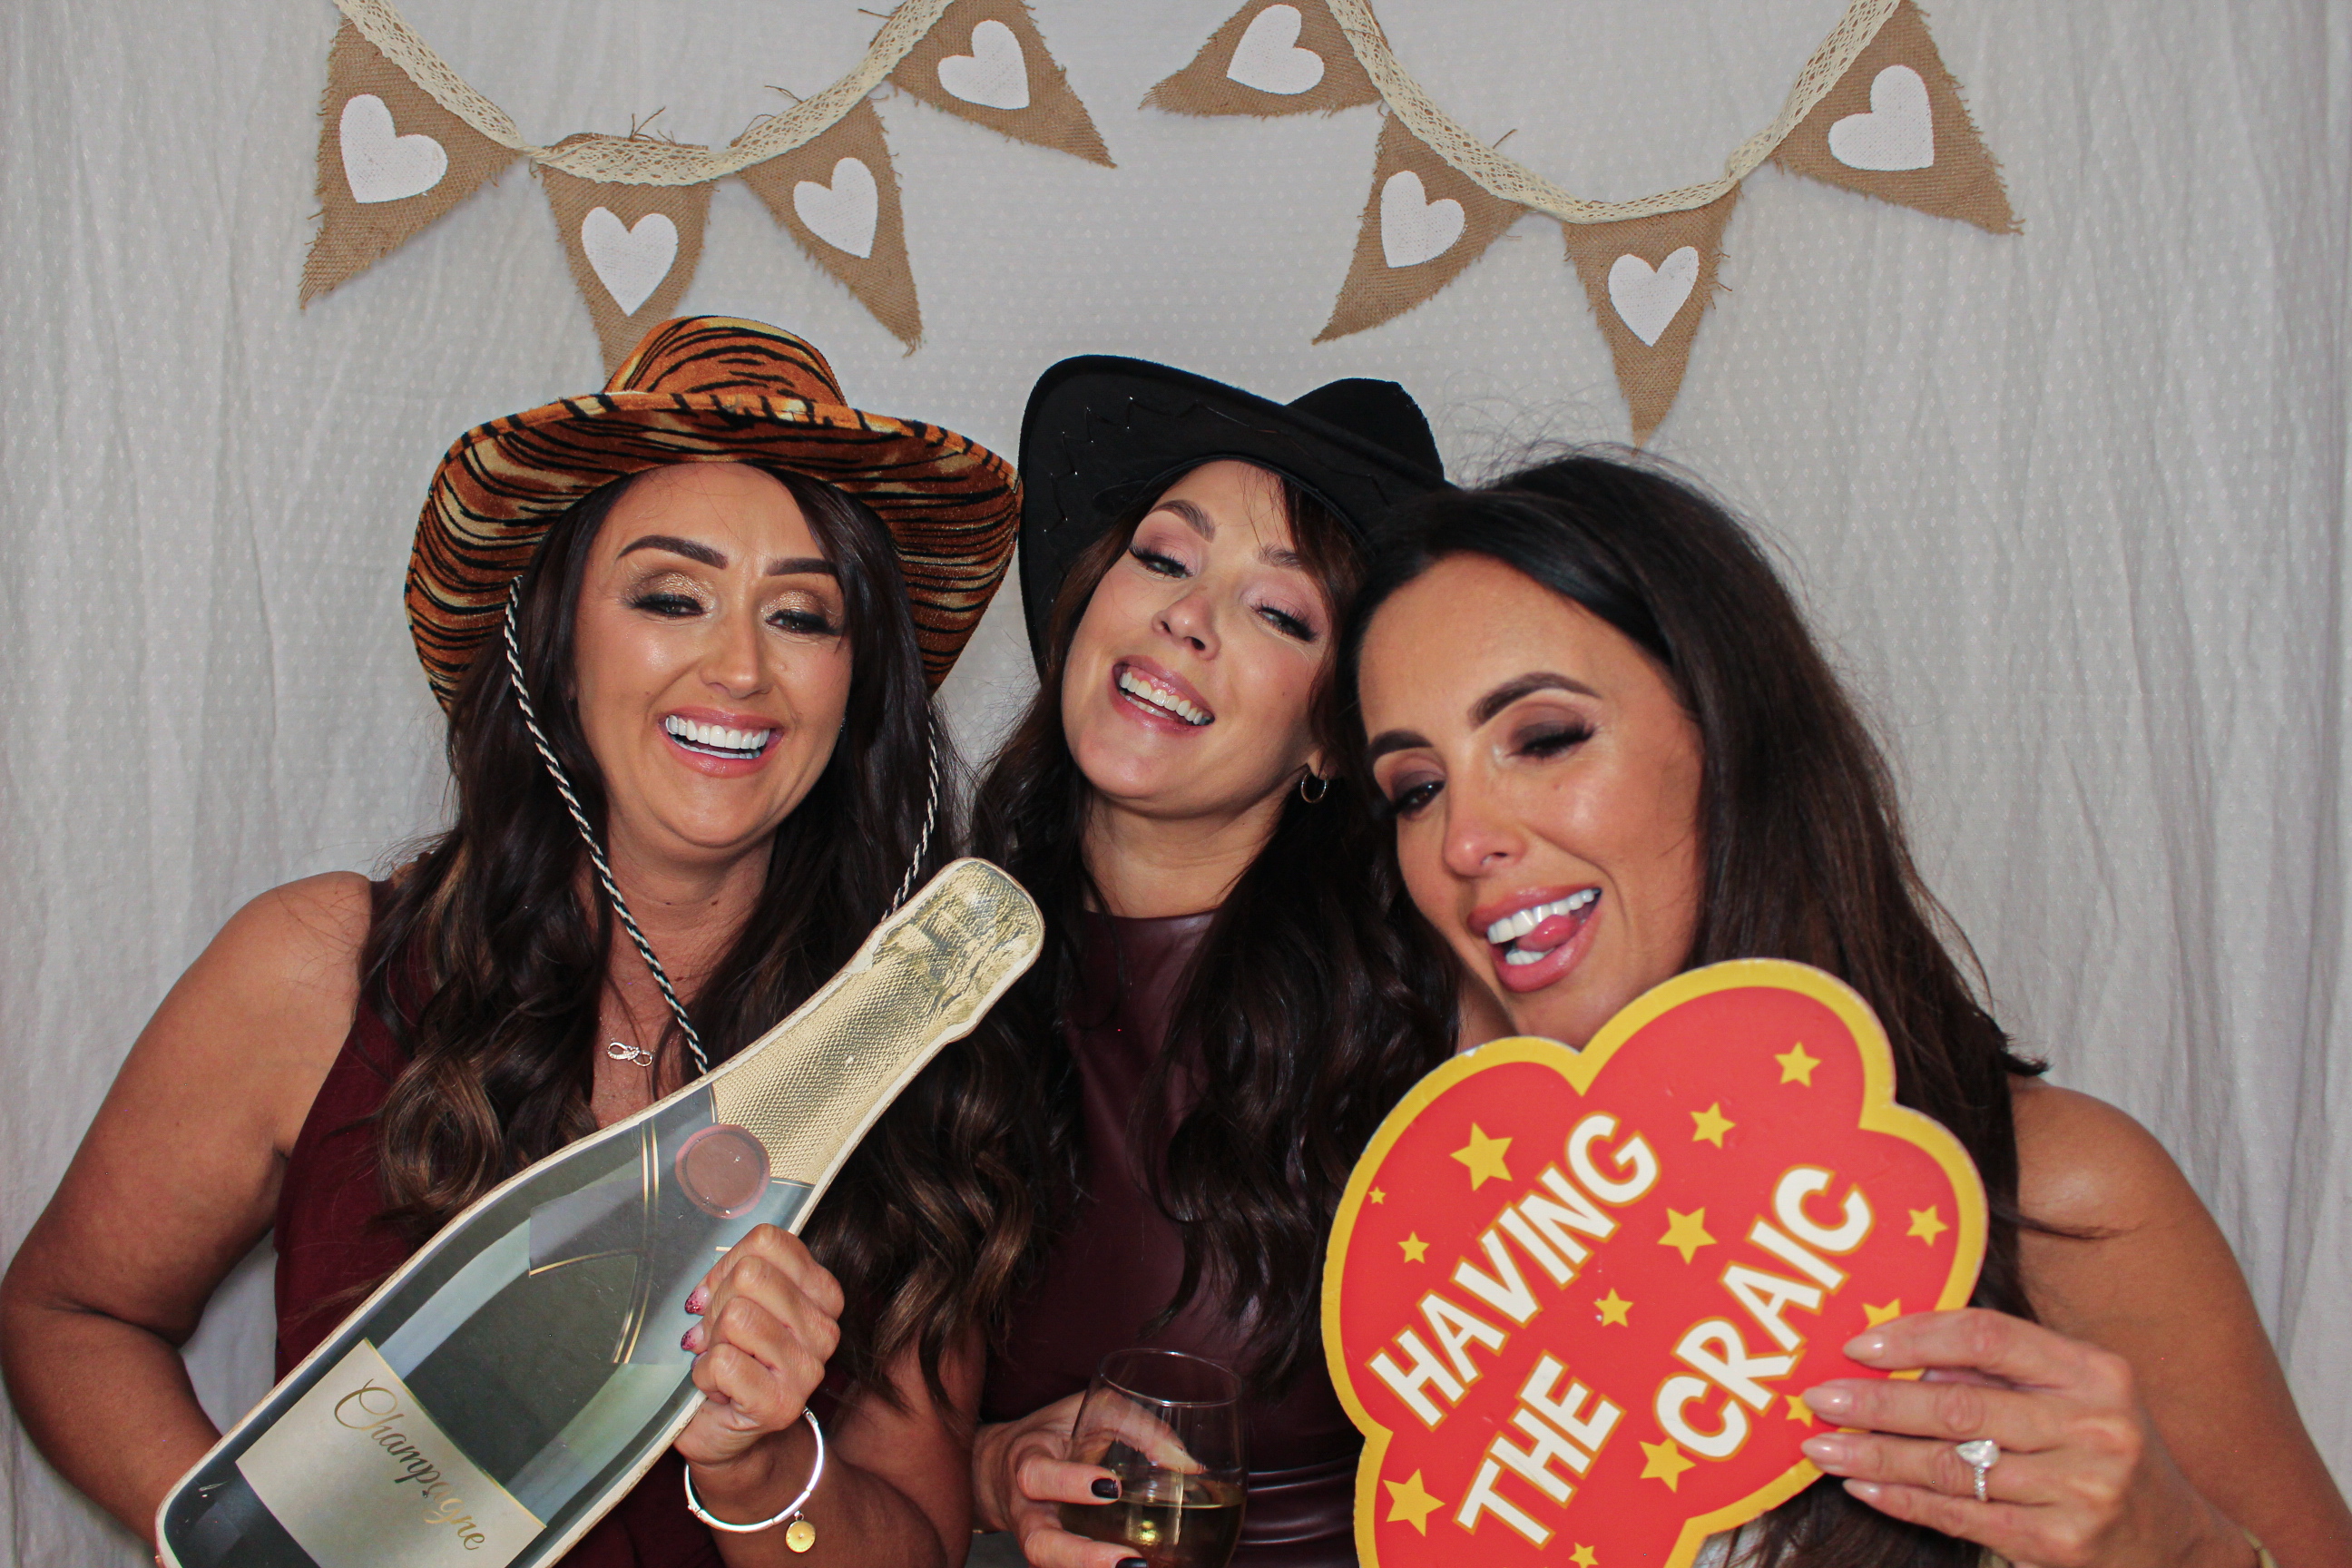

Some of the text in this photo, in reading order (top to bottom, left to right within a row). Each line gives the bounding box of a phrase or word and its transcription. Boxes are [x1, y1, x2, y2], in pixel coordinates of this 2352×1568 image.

[1367, 1112, 1660, 1428] HAVING
[1654, 1166, 1873, 1459] CRAIC
[334, 1378, 485, 1551] Champagne
[1455, 1353, 1625, 1547] THE
